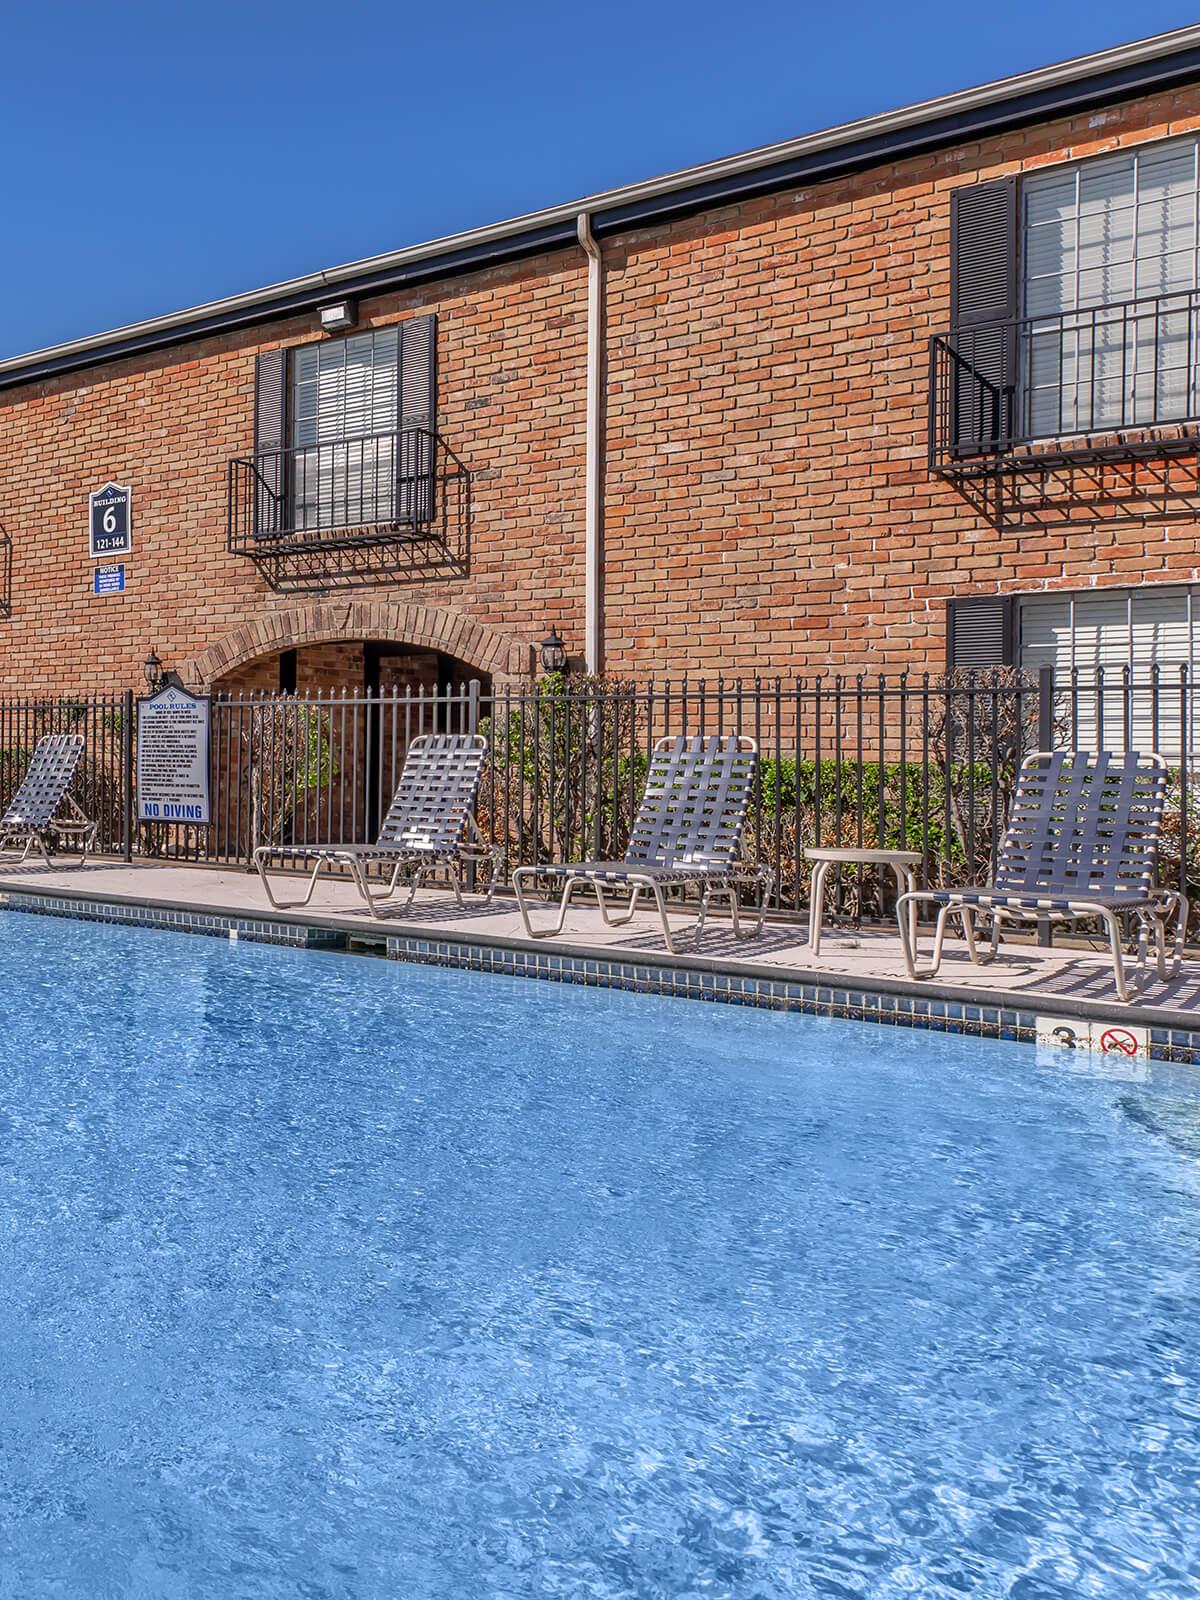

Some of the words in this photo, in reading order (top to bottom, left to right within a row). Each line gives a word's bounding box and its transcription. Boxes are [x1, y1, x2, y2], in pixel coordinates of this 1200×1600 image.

[93, 495, 127, 507] BUILDING
[103, 506, 116, 533] 6
[96, 536, 125, 550] 121-144
[100, 565, 119, 574] NOTICE
[144, 803, 160, 817] NO
[163, 803, 203, 819] DIVING
[1052, 1026, 1077, 1048] 3
